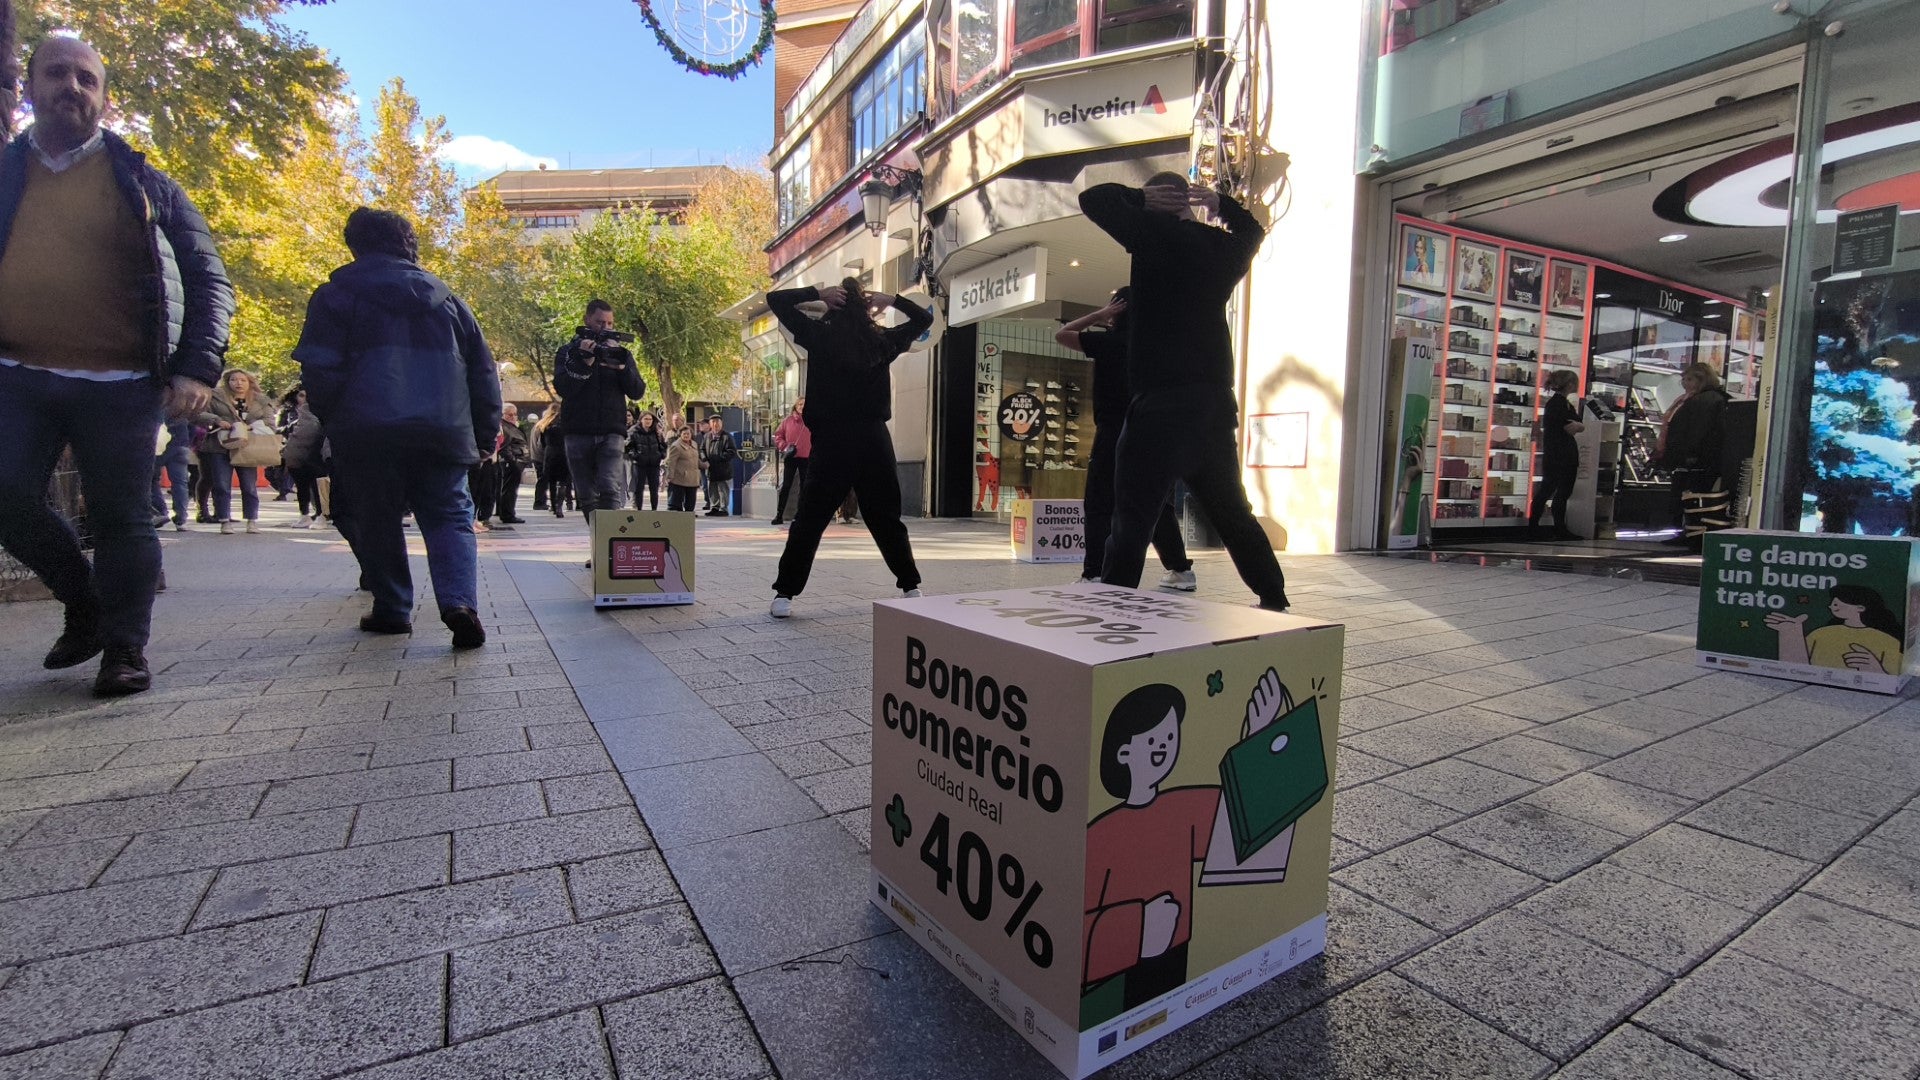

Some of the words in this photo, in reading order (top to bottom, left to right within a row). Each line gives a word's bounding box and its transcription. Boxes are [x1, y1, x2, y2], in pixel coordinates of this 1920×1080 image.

[1044, 96, 1136, 128] helvetia
[961, 267, 1020, 309] sötkatt
[1658, 289, 1685, 314] Dior
[1045, 504, 1080, 515] Bonos
[1051, 534, 1086, 550] 40%
[1719, 543, 1752, 563] Te
[1760, 544, 1868, 570] damos
[1718, 568, 1753, 584] un
[1762, 566, 1837, 590] buen
[1716, 587, 1785, 609] trato
[989, 607, 1159, 646] 40%
[905, 635, 1028, 731] Bonos
[882, 692, 1064, 814] comercio
[916, 757, 965, 803] Ciudad
[968, 787, 1003, 824] Real
[919, 811, 1054, 969] 40%
